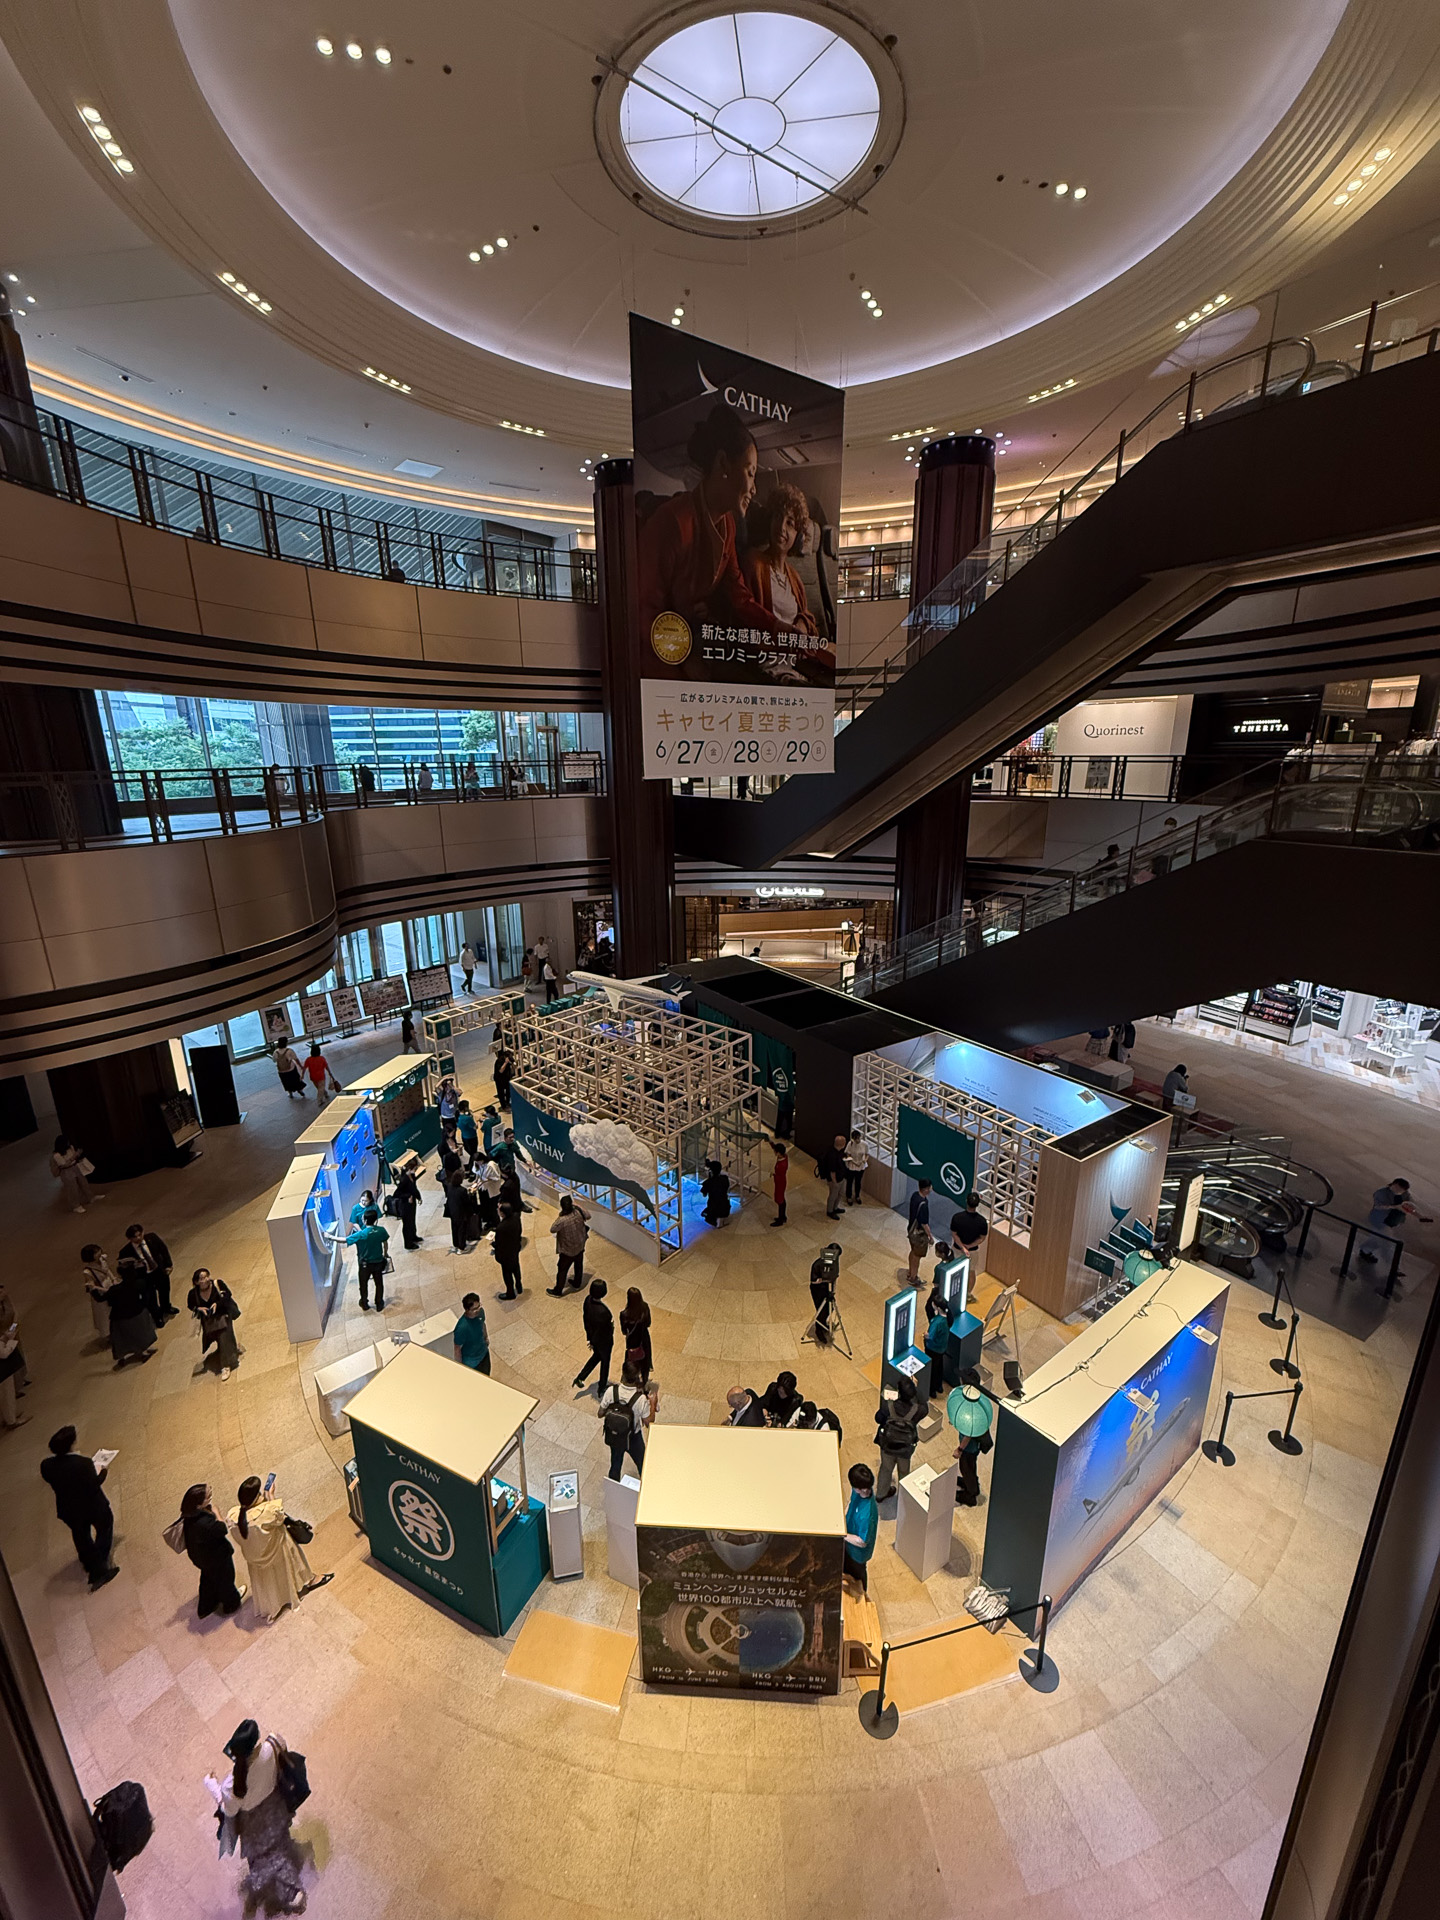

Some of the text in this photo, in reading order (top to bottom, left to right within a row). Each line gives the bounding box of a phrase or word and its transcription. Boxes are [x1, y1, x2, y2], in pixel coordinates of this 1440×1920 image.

[724, 386, 792, 423] CATHAY
[701, 624, 829, 650] 新たな感動を、世界最高の
[702, 647, 797, 667] エコノミークラスで
[680, 693, 808, 707] 広がるプレミアムの翼で、旅に出よう。
[656, 708, 825, 733] キャセイ夏空まつり
[1083, 724, 1145, 738] Quorinest
[1233, 724, 1289, 732] TENERITA
[525, 1134, 565, 1163] CATHAY
[1140, 1352, 1174, 1390] CATHAY
[398, 1455, 441, 1485] CATHAY
[398, 1489, 443, 1553] 祭
[678, 1593, 803, 1609] 世界100都市以上へ就航。
